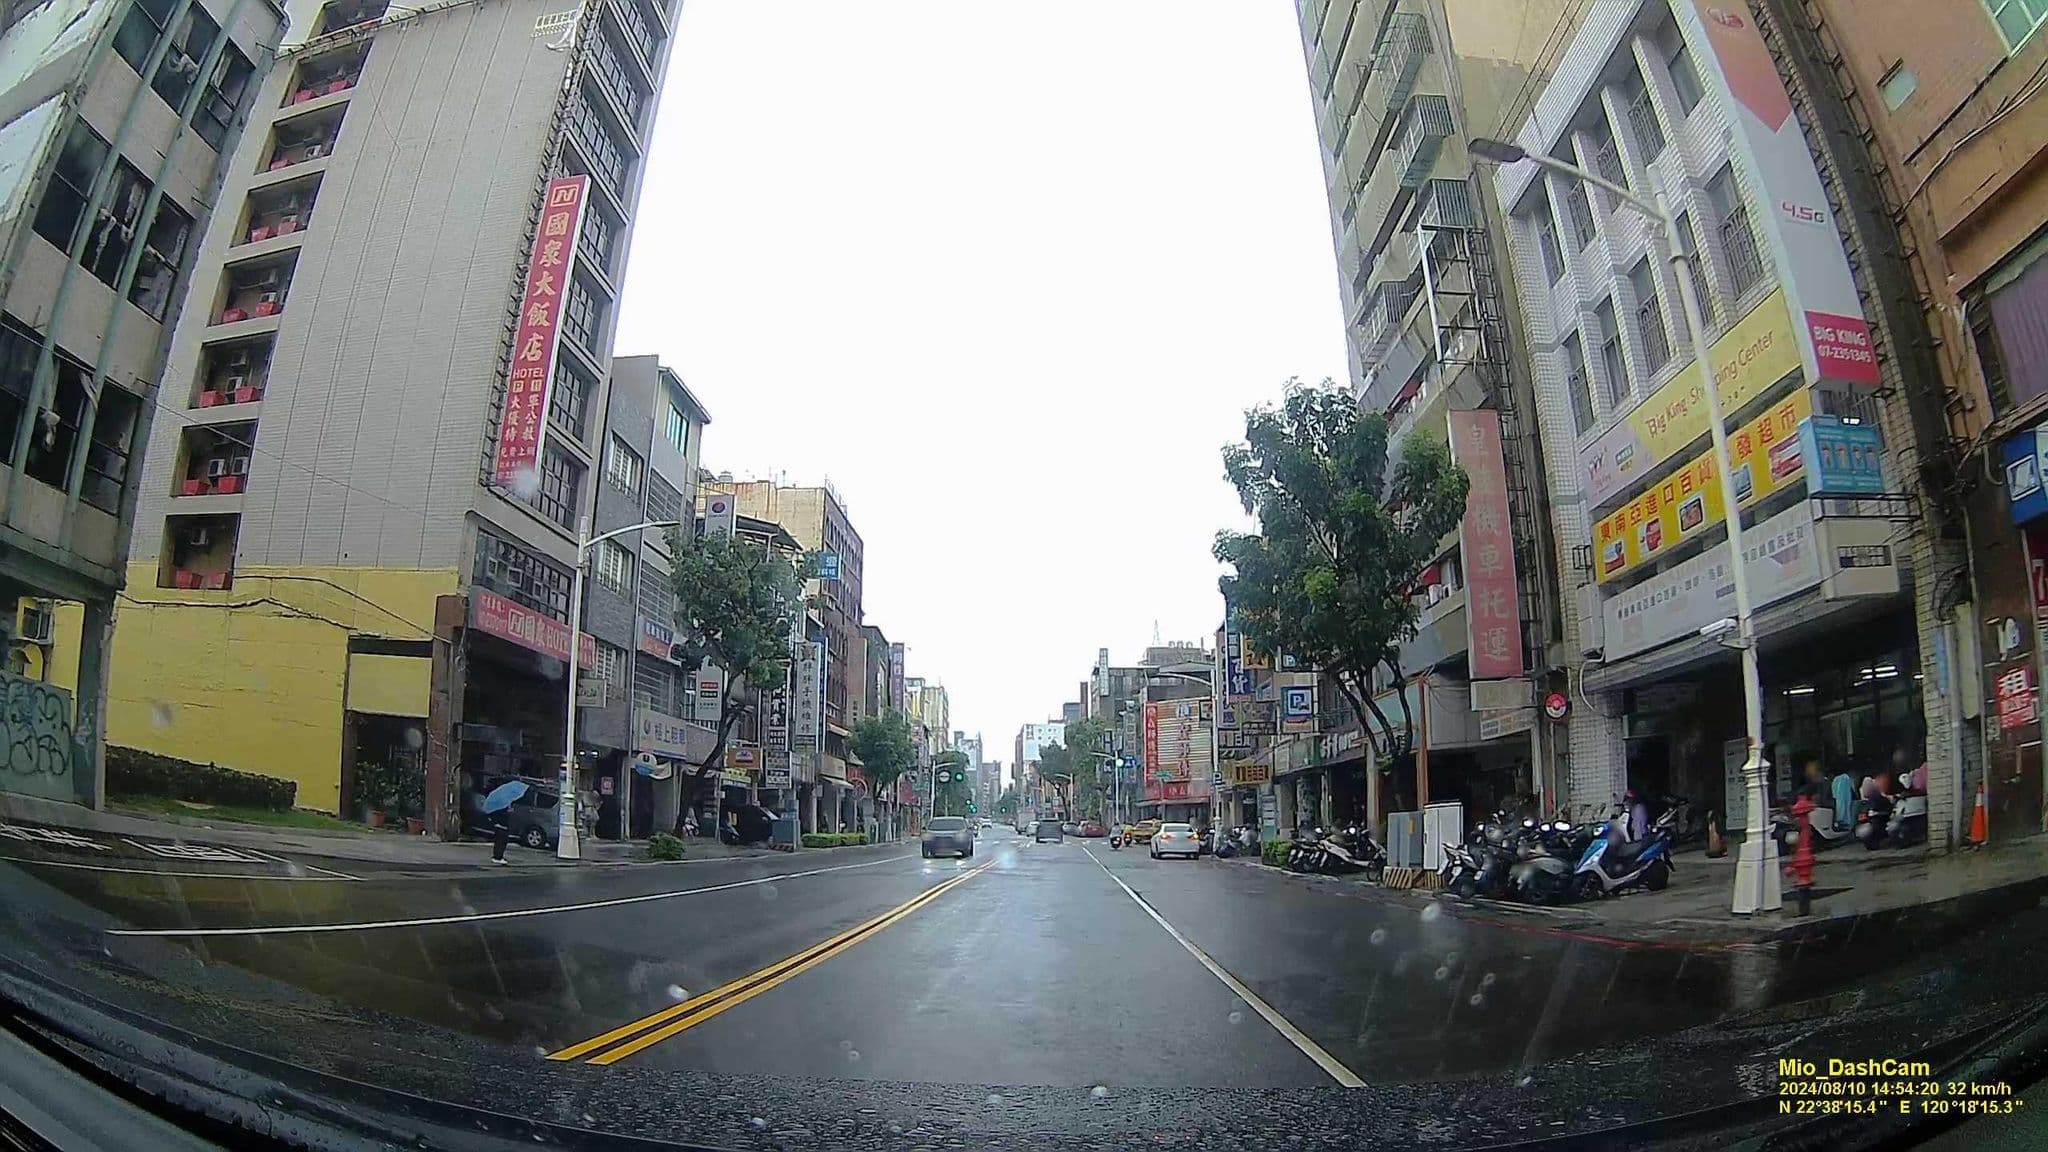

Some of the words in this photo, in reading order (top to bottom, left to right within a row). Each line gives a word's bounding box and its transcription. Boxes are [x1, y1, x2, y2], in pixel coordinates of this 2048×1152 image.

[1782, 201, 1824, 223] 4.5G
[518, 213, 569, 363] 國家大飯店
[1813, 326, 1836, 342] BIG
[1836, 328, 1867, 346] KING
[513, 367, 544, 379] HOTEL
[1690, 359, 1738, 406] Shping
[1738, 329, 1775, 366] Center
